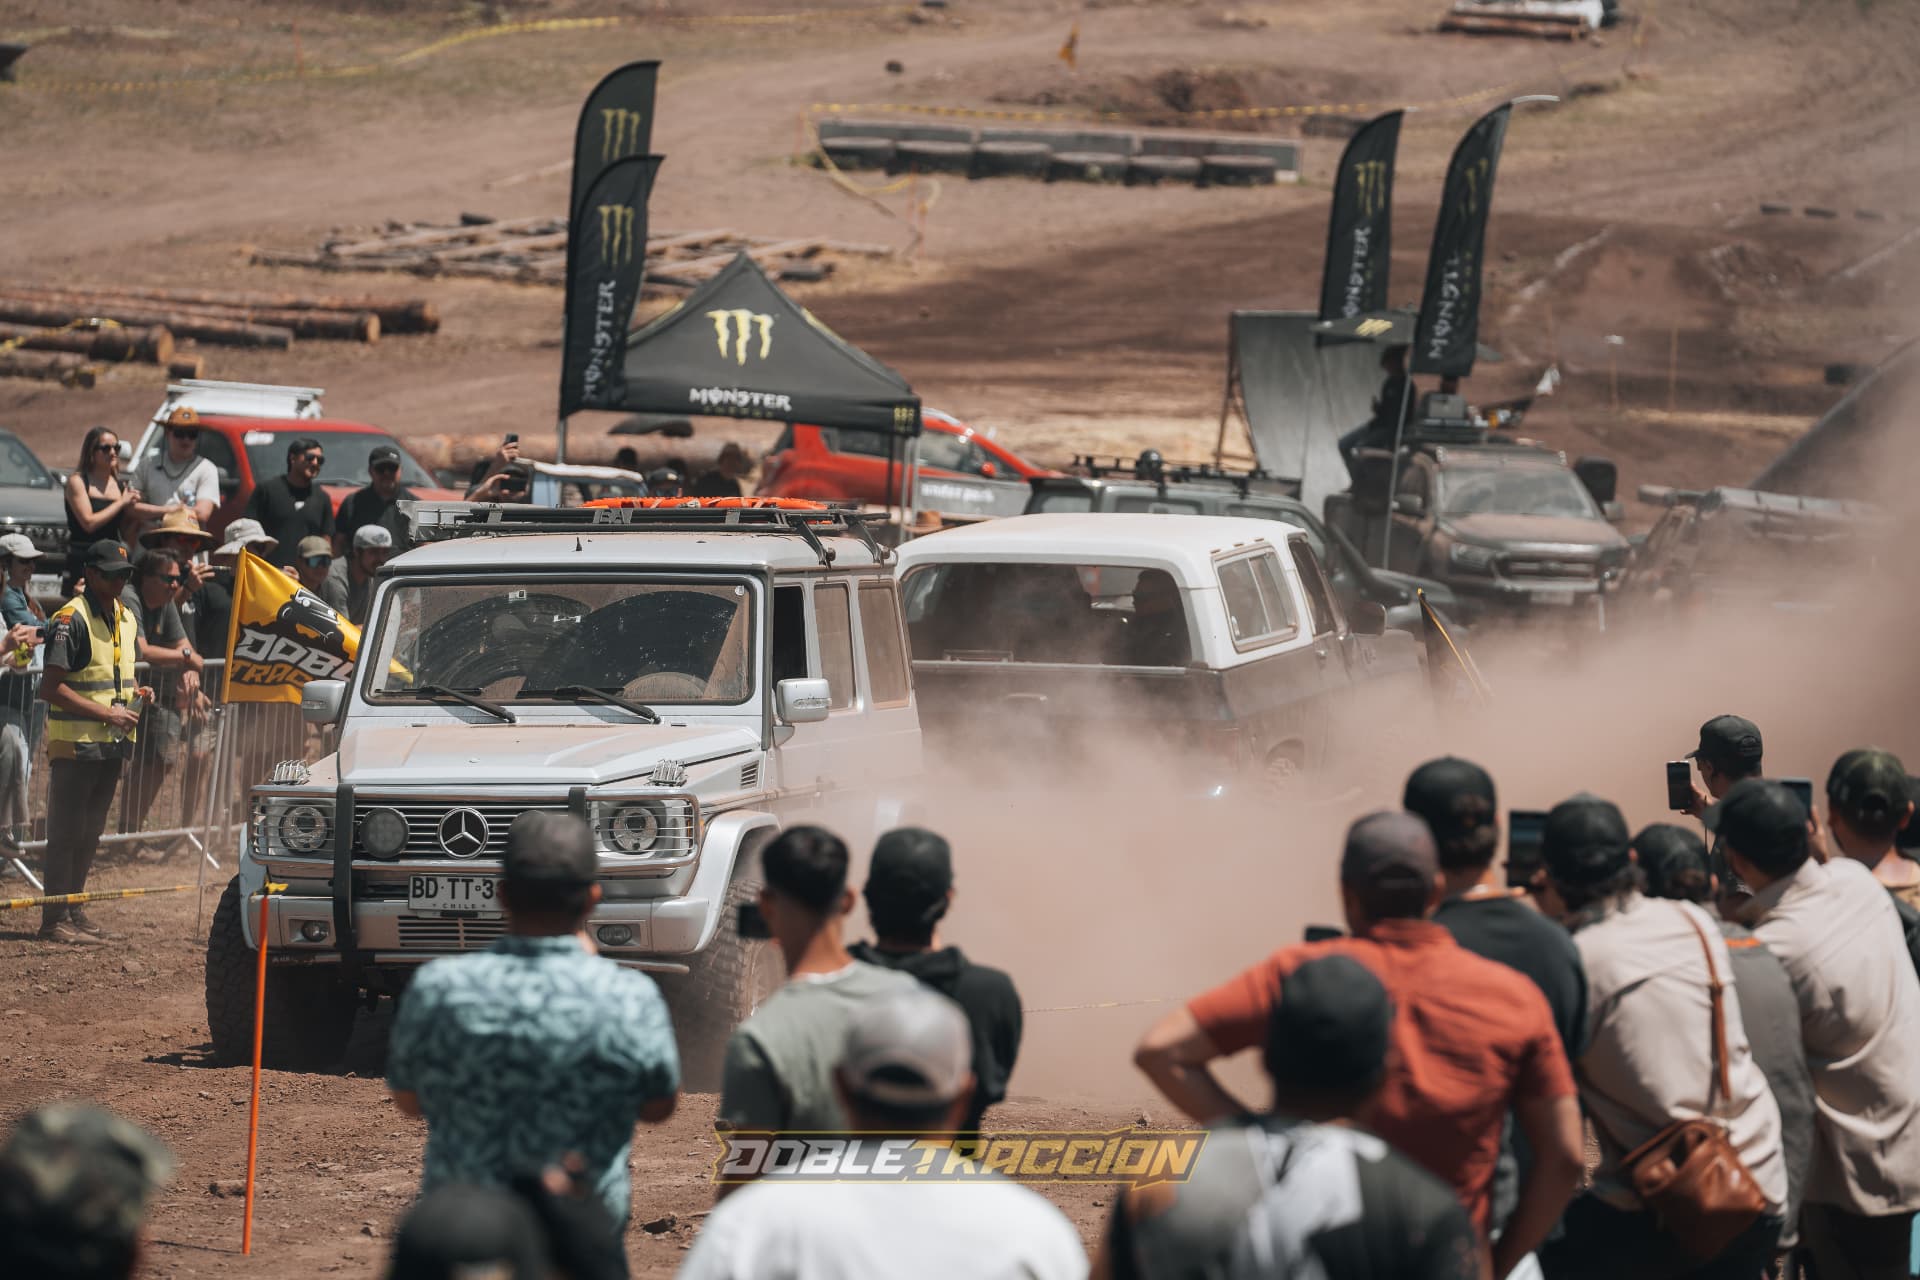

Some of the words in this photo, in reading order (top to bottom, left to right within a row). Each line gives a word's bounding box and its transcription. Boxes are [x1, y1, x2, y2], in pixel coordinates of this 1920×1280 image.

[1342, 226, 1371, 319] ONSTER
[689, 387, 792, 412] MONSTER
[230, 660, 315, 689] TRAC
[235, 628, 354, 682] DOBL
